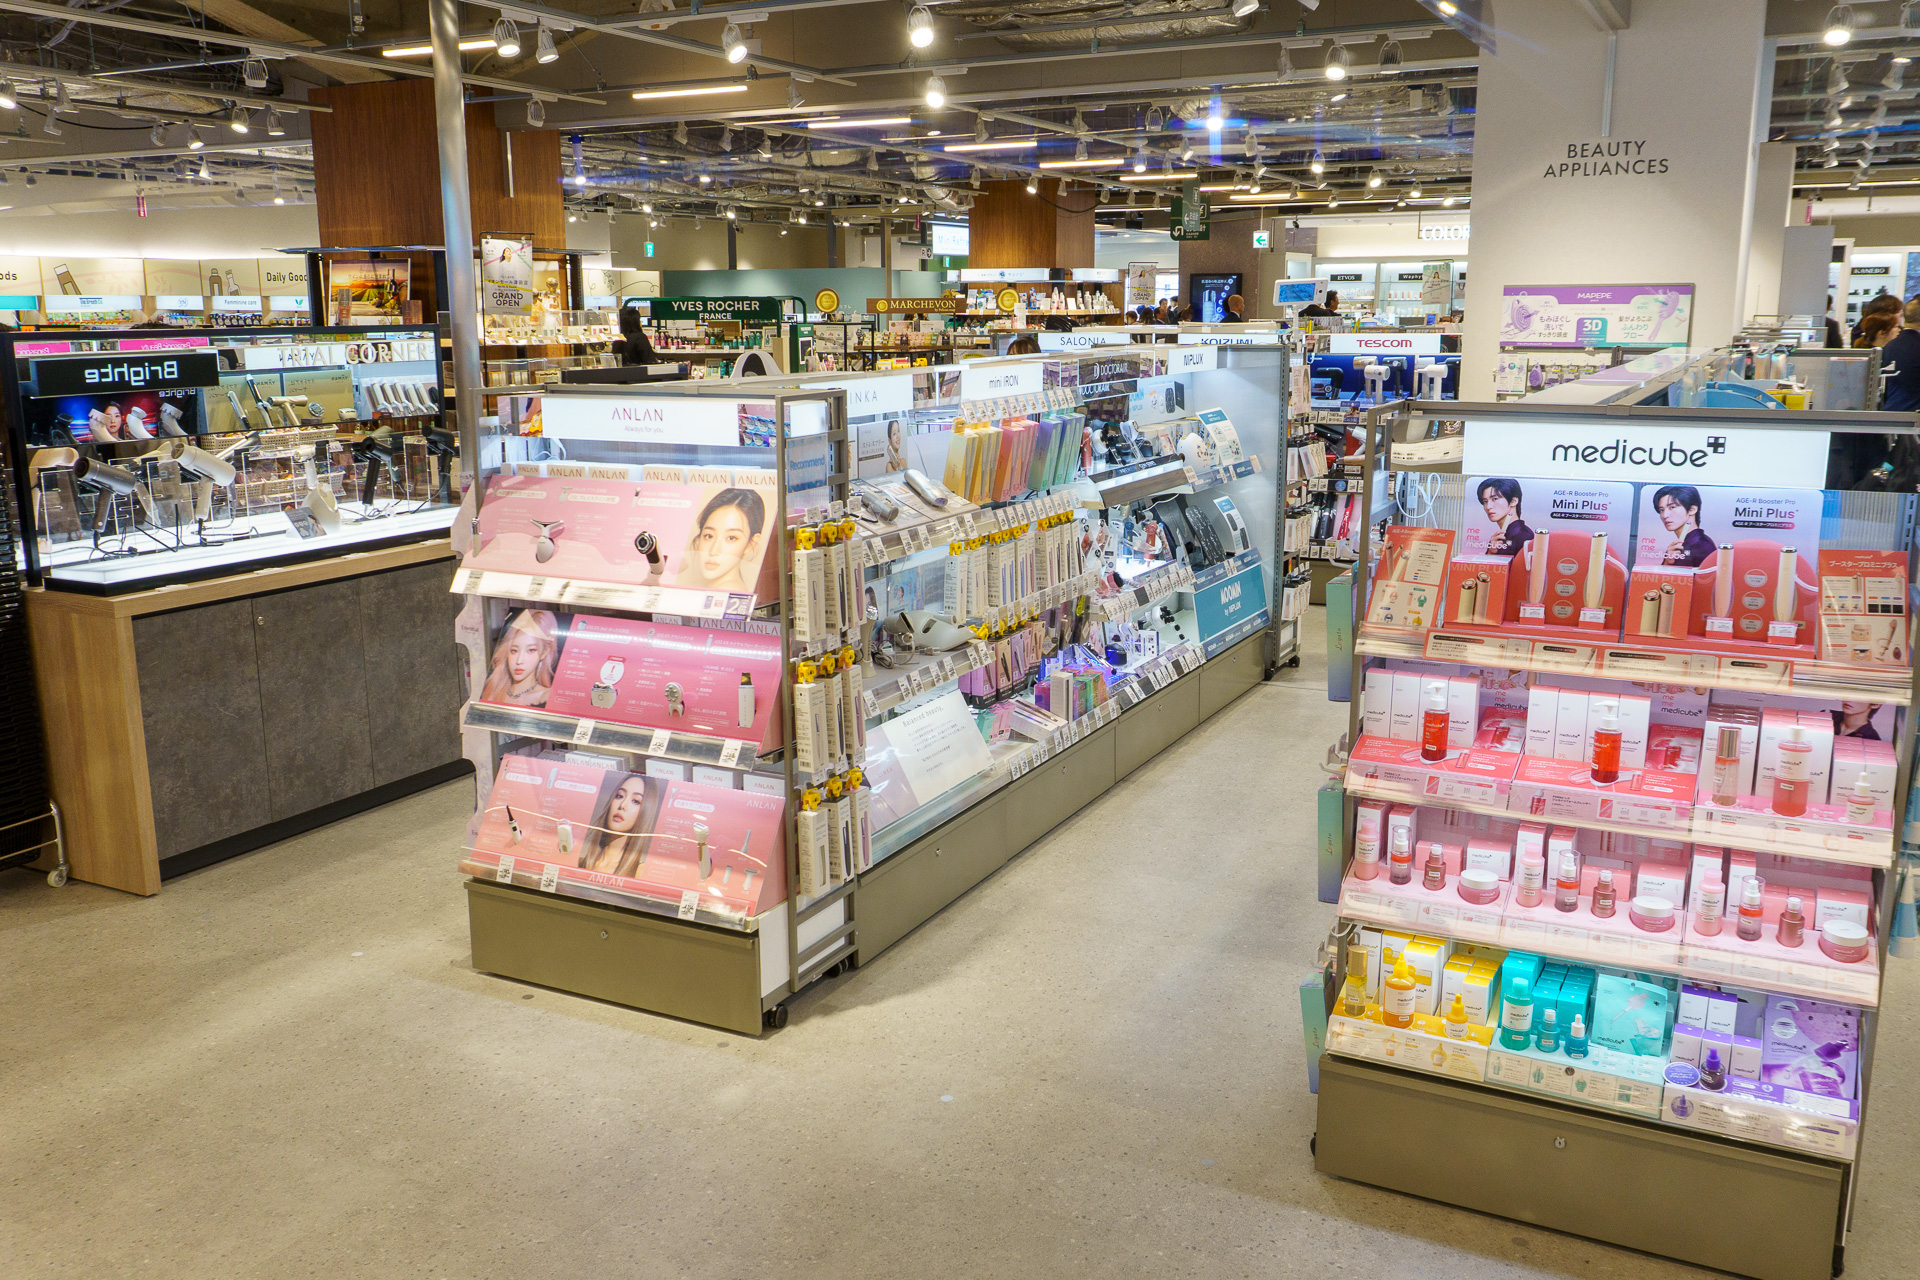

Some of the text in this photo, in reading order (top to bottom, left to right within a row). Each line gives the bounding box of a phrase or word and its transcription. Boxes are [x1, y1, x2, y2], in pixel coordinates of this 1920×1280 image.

[1567, 140, 1646, 158] BEAUTY
[1543, 159, 1669, 178] APPLIANCES
[267, 272, 286, 284] Daily
[492, 292, 523, 300] GRAND
[672, 301, 760, 311] YVES ROCHER
[890, 300, 956, 309] MARCHEVON
[1539, 315, 1571, 323] もみほぐし
[1582, 319, 1602, 331] 3D
[1060, 336, 1106, 346] SALONIA
[1356, 339, 1412, 348] TESCOM
[277, 346, 340, 368] TRIAL
[345, 342, 428, 364] CORNER
[1100, 362, 1128, 376] DOCTORAIR
[989, 378, 1018, 389] mini IRON
[612, 407, 664, 421] ANLAN
[1552, 439, 1709, 467] medicube
[789, 455, 826, 471] Recommend
[549, 467, 582, 477] ANLAN
[591, 469, 626, 480] ANLAN
[645, 470, 680, 481] ANLAN
[690, 473, 727, 484] ANLAN
[737, 474, 776, 486] ANLAN
[1552, 499, 1578, 510] Mini
[1734, 507, 1763, 518] Mini
[1466, 540, 1508, 549] medicube
[1640, 550, 1686, 560] medicube
[1451, 563, 1508, 574] MINI PLUS
[1829, 560, 1898, 568] ブースタープロミニプラス
[1631, 574, 1694, 586] MINI PLUS
[655, 616, 679, 625] ANLAN
[703, 619, 742, 631] ANLAN
[1661, 707, 1699, 717] medicube
[902, 711, 926, 727] Balanced
[567, 757, 590, 767] ANLAN
[591, 761, 616, 771] ANLAN
[655, 768, 674, 776] ANLAN
[702, 774, 723, 783] ANLAN
[753, 782, 775, 790] ANLAN
[746, 799, 777, 811] ANLAN
[588, 873, 624, 887] ANLAN
[1597, 1036, 1623, 1045] medicube
[1771, 1041, 1803, 1050] medicube
